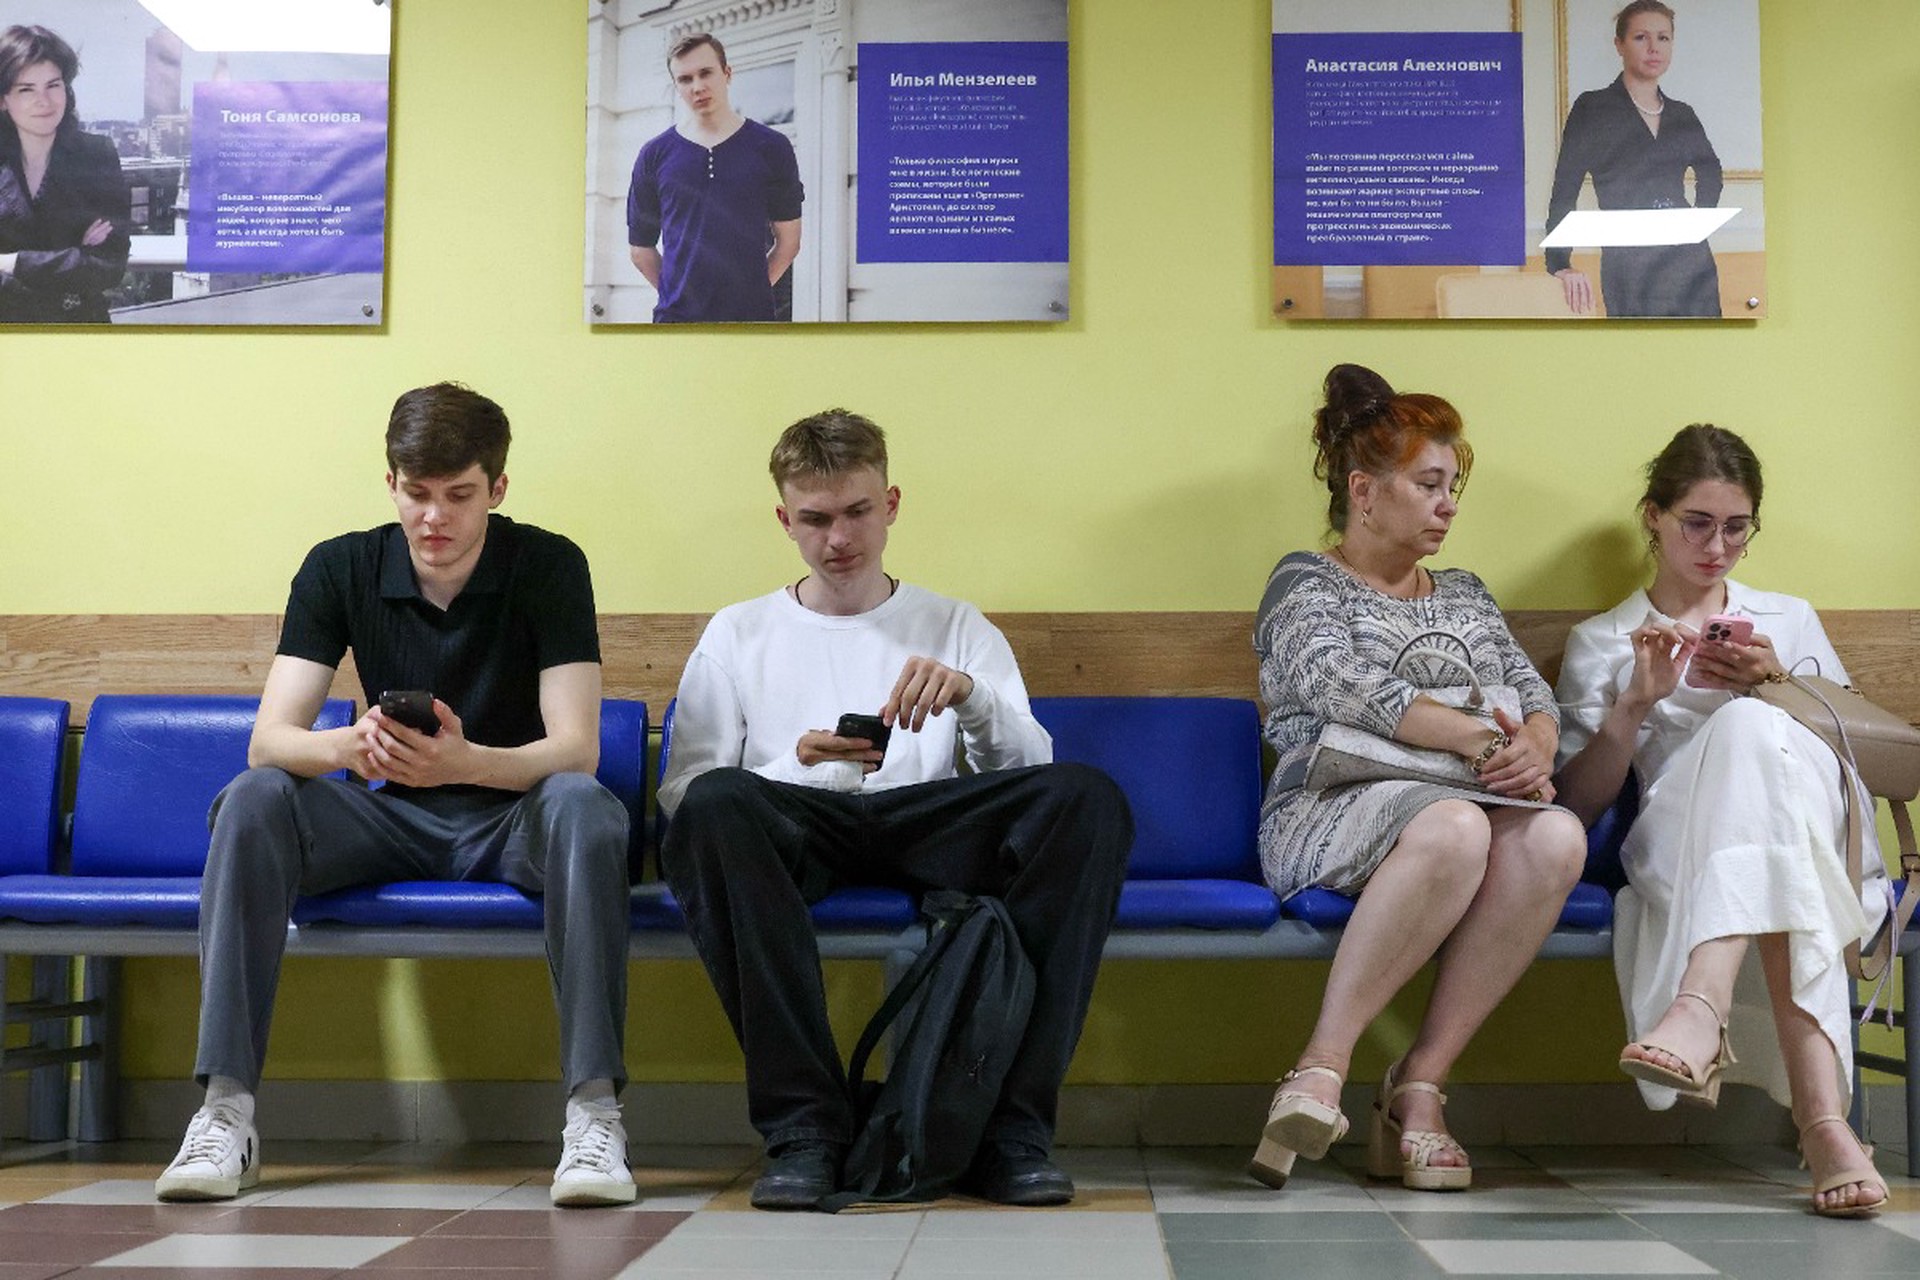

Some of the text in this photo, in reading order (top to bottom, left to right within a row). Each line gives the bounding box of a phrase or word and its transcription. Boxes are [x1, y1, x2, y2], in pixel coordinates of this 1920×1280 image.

[1306, 58, 1502, 72] Анастасия Алехнович
[890, 72, 1037, 87] Илья Мензелеев
[220, 110, 361, 123] Тоня Самсонова
[928, 157, 980, 166] философия
[1379, 154, 1444, 162] пересекаемся
[1452, 152, 1474, 161] alma
[952, 168, 967, 176] Все
[968, 169, 1021, 177] логические
[1386, 166, 1431, 174] вопросам
[1441, 166, 1499, 174] неразрывно
[923, 181, 963, 190] которые
[964, 179, 989, 188] были
[1306, 188, 1357, 196] возникают
[1358, 188, 1394, 197] жаркие
[262, 193, 323, 203] невероятный
[217, 204, 351, 214] инкубатор возможностей для
[947, 205, 959, 213] до
[977, 205, 995, 213] пор
[1371, 212, 1423, 220] платформа
[1425, 212, 1443, 220] для
[250, 217, 289, 226] которые
[321, 226, 345, 236] быть
[1306, 234, 1385, 244] преобразований
